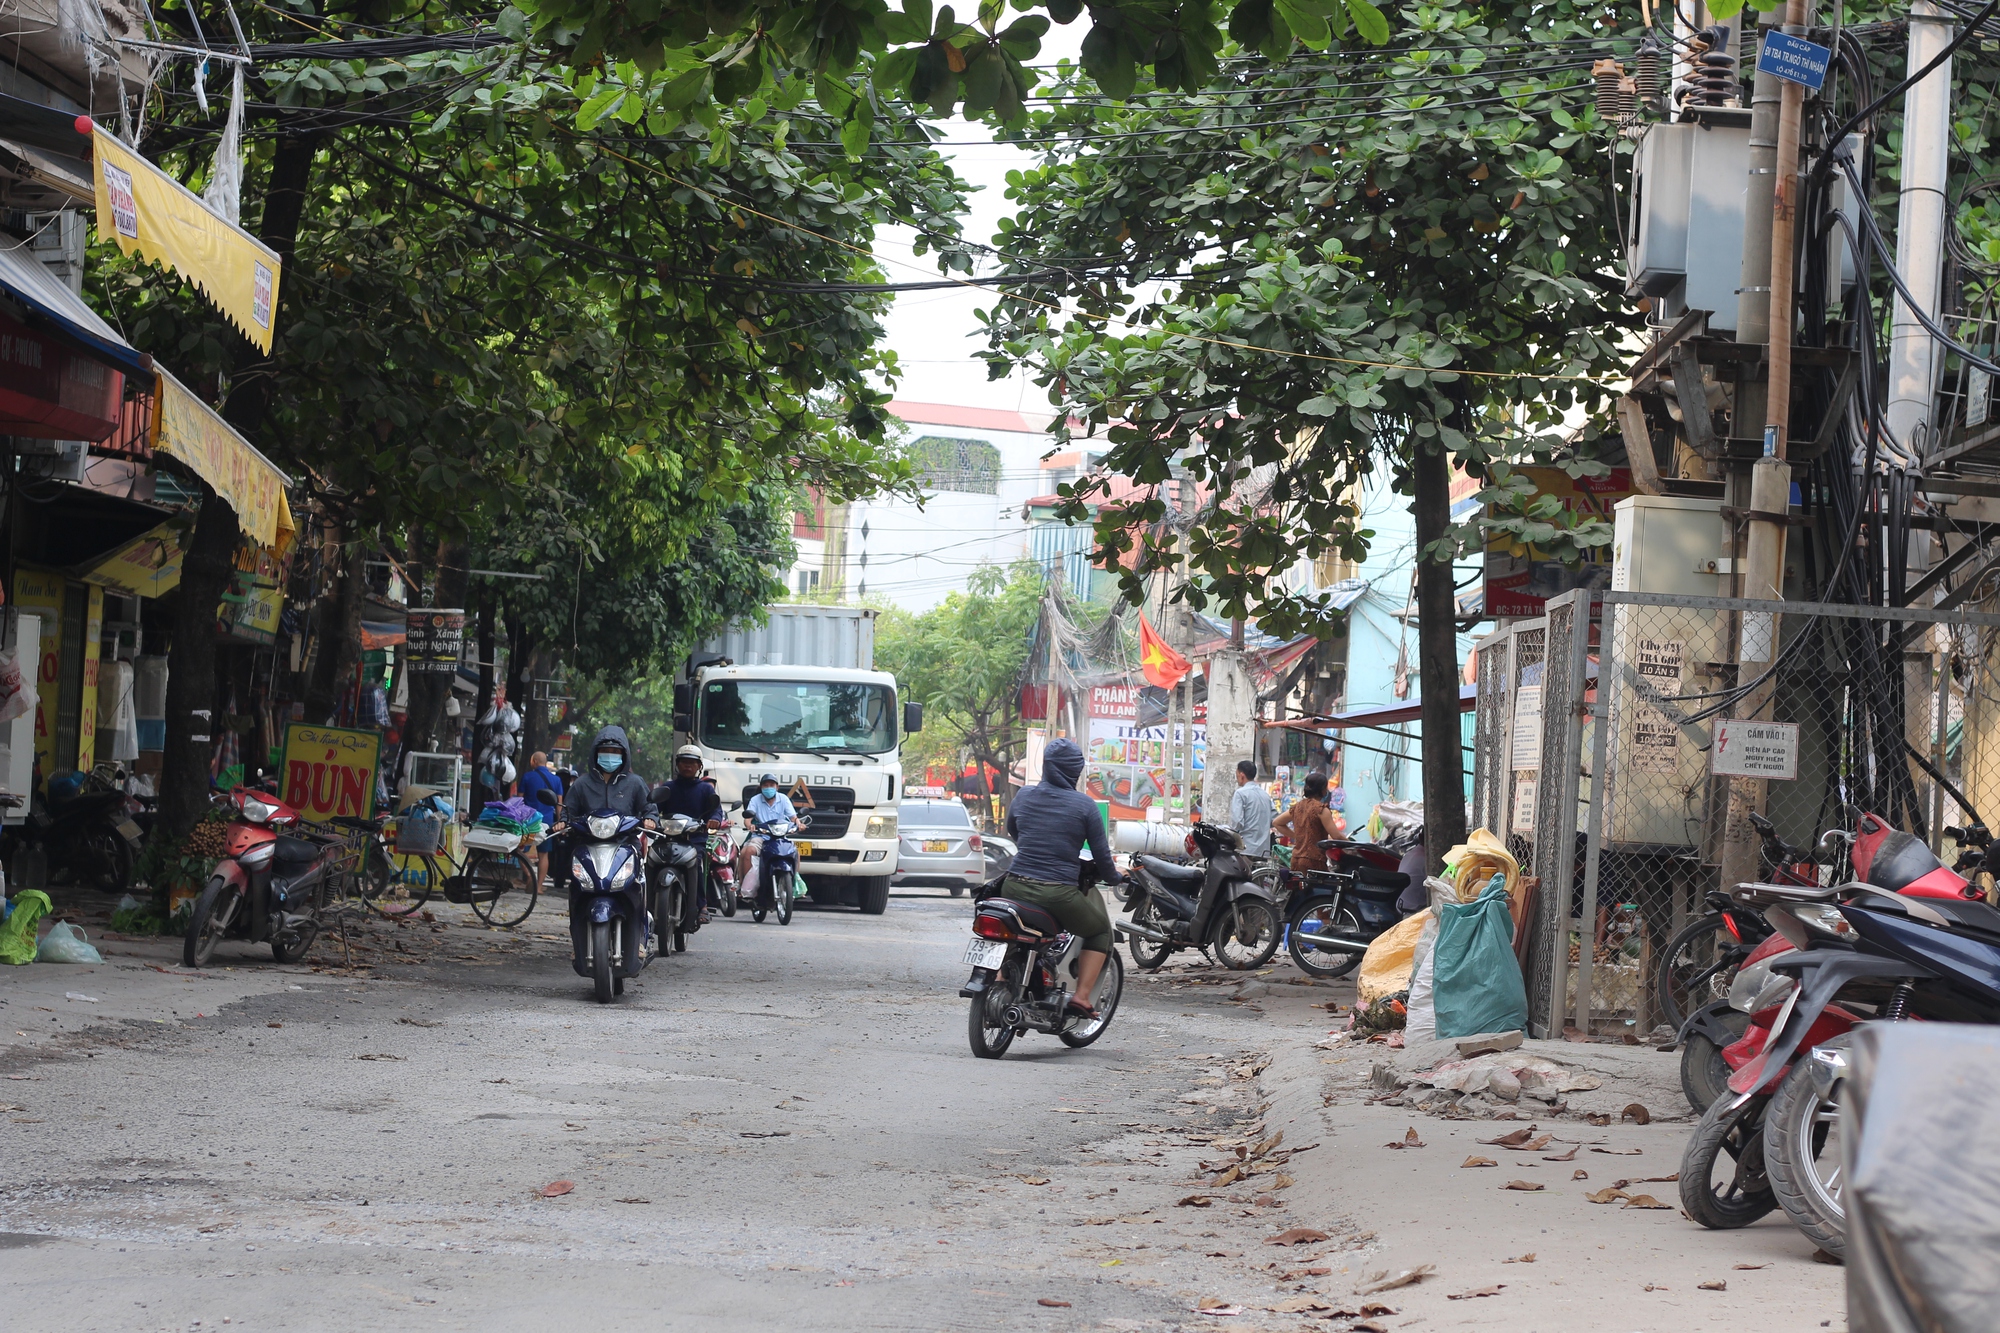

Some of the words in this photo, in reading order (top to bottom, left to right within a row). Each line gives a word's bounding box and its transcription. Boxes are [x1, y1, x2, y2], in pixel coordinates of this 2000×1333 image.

[1771, 48, 1781, 59] TBA
[1496, 605, 1510, 615] ĐC:
[1512, 605, 1521, 615] 72
[408, 640, 428, 653] huật
[431, 641, 453, 653] Nghệ
[1643, 666, 1653, 674] 10
[1654, 665, 1668, 676] ĂN
[1094, 686, 1127, 703] PHÂN
[1094, 702, 1109, 715] TỦ
[1748, 727, 1764, 739] CẤM
[284, 748, 371, 818] BÚN
[749, 774, 851, 786] HUNDAI
[966, 952, 1002, 968] 109.05
